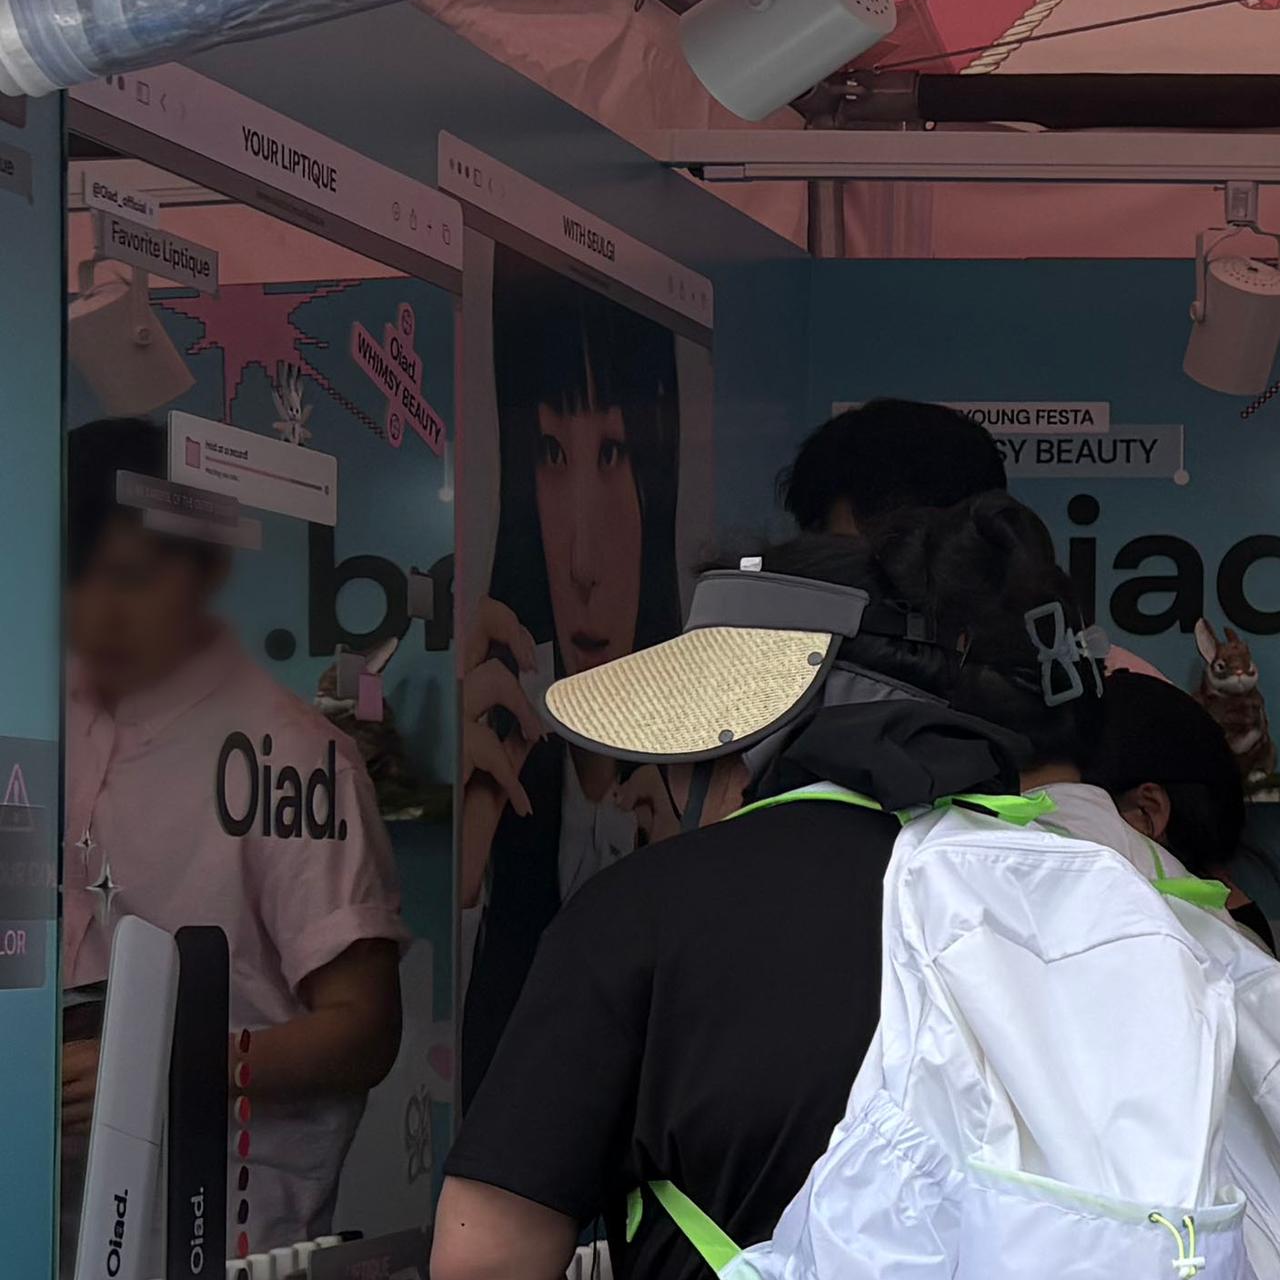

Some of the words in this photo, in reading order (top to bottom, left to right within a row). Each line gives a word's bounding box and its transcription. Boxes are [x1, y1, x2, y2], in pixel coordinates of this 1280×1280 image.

[242, 125, 278, 166] YOUR
[281, 143, 337, 193] LIPTIQUE
[111, 220, 161, 259] Favorite
[163, 241, 210, 279] Liptique
[357, 332, 401, 397] WHIMSY
[402, 386, 441, 445] BEAUTY
[1036, 409, 1094, 425] FESTA
[1036, 438, 1158, 465] BEAUTY
[216, 731, 347, 840] Oiad.
[107, 1188, 128, 1278] Oiad.
[190, 1186, 204, 1275] Oiad.
